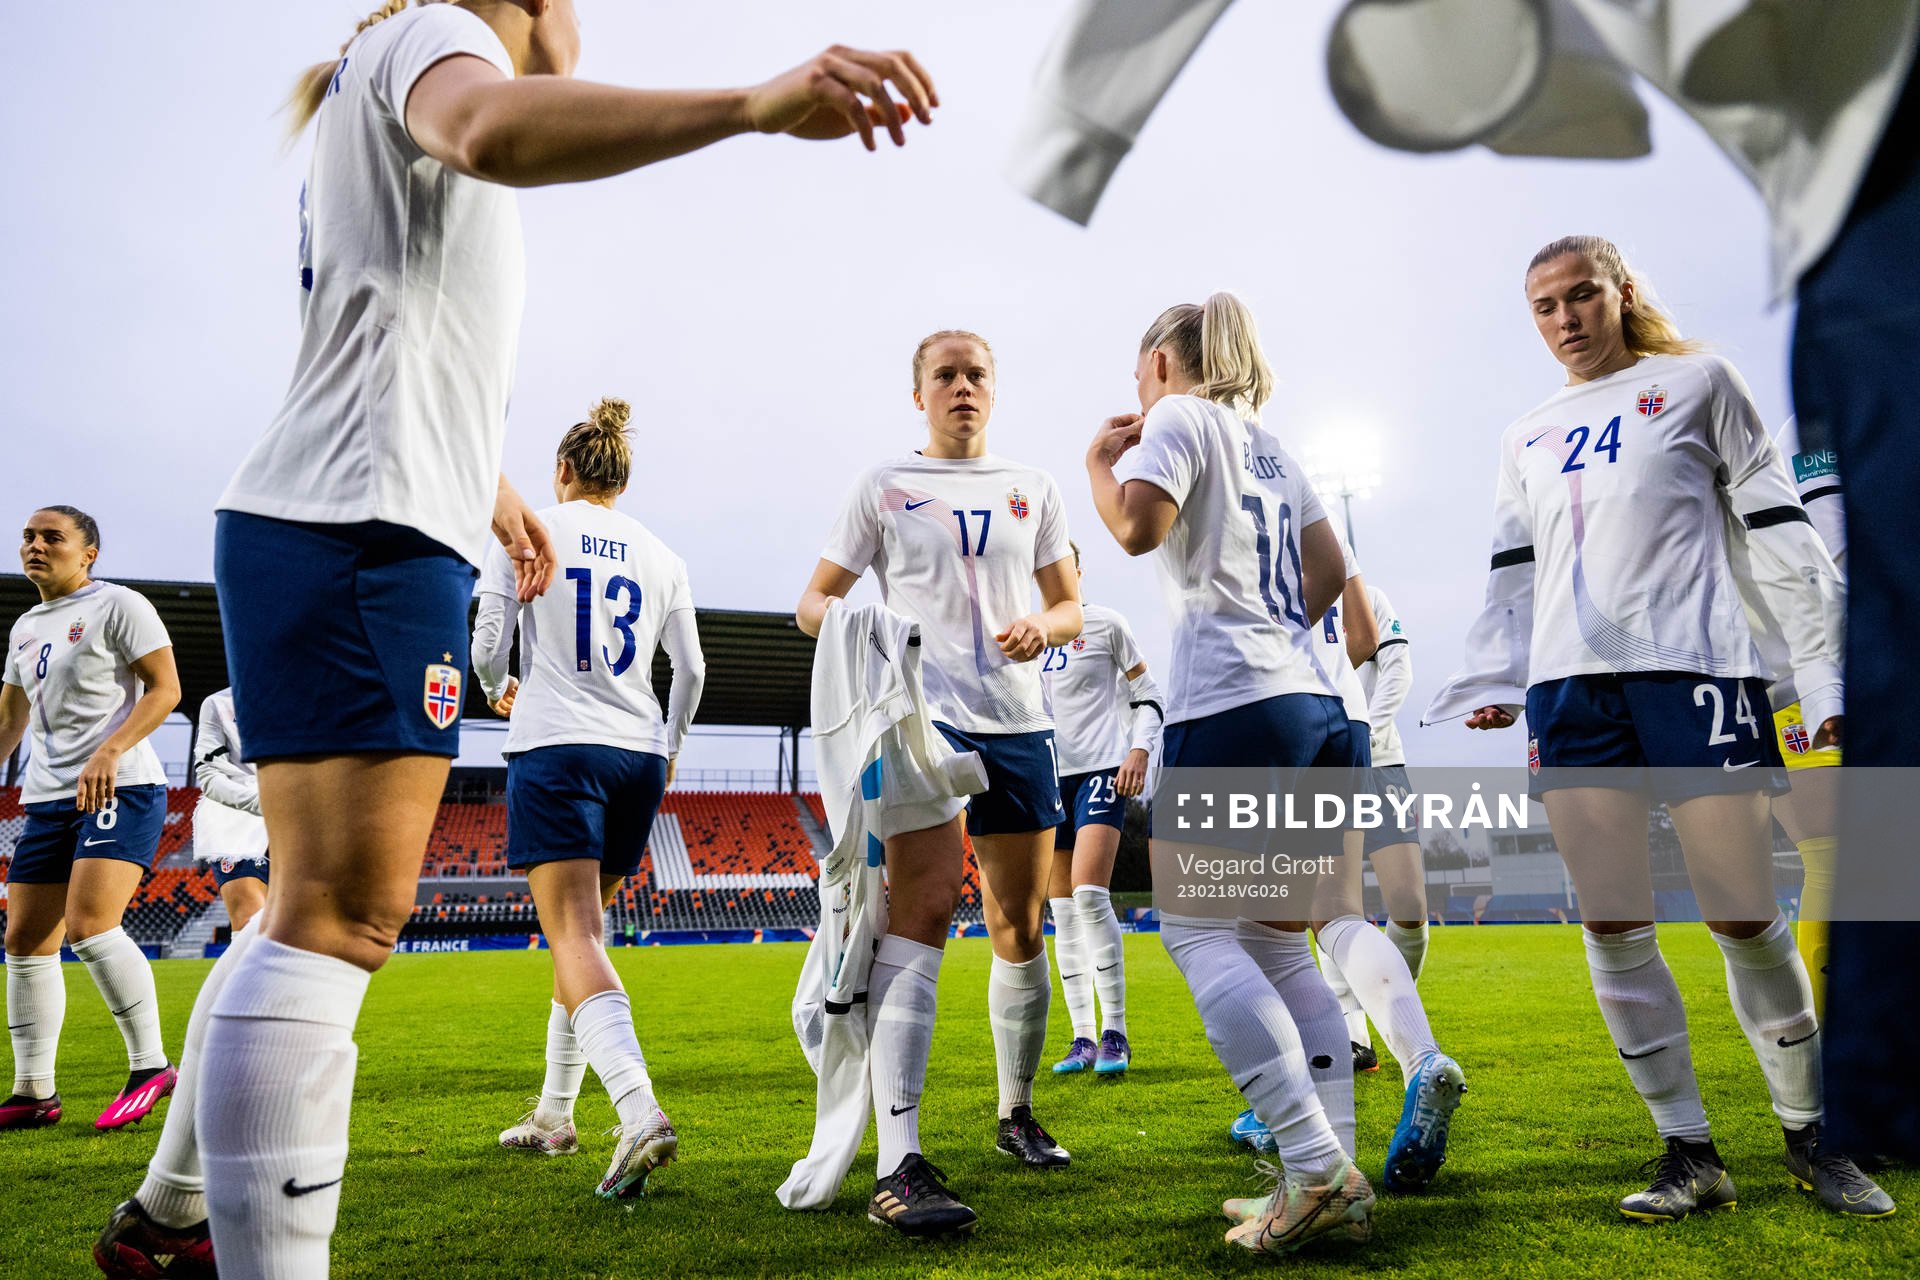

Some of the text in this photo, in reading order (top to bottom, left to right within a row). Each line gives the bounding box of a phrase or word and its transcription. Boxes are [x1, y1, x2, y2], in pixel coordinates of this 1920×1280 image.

[1560, 415, 1622, 474] 24
[581, 534, 628, 562] BIZET
[952, 510, 992, 556] 17
[1241, 493, 1312, 632] 10
[565, 567, 642, 677] 13
[36, 643, 52, 679] 8
[1693, 679, 1760, 746] 24
[1087, 775, 1117, 804] 25
[96, 796, 119, 830] 8
[412, 939, 470, 952] FRANCE
